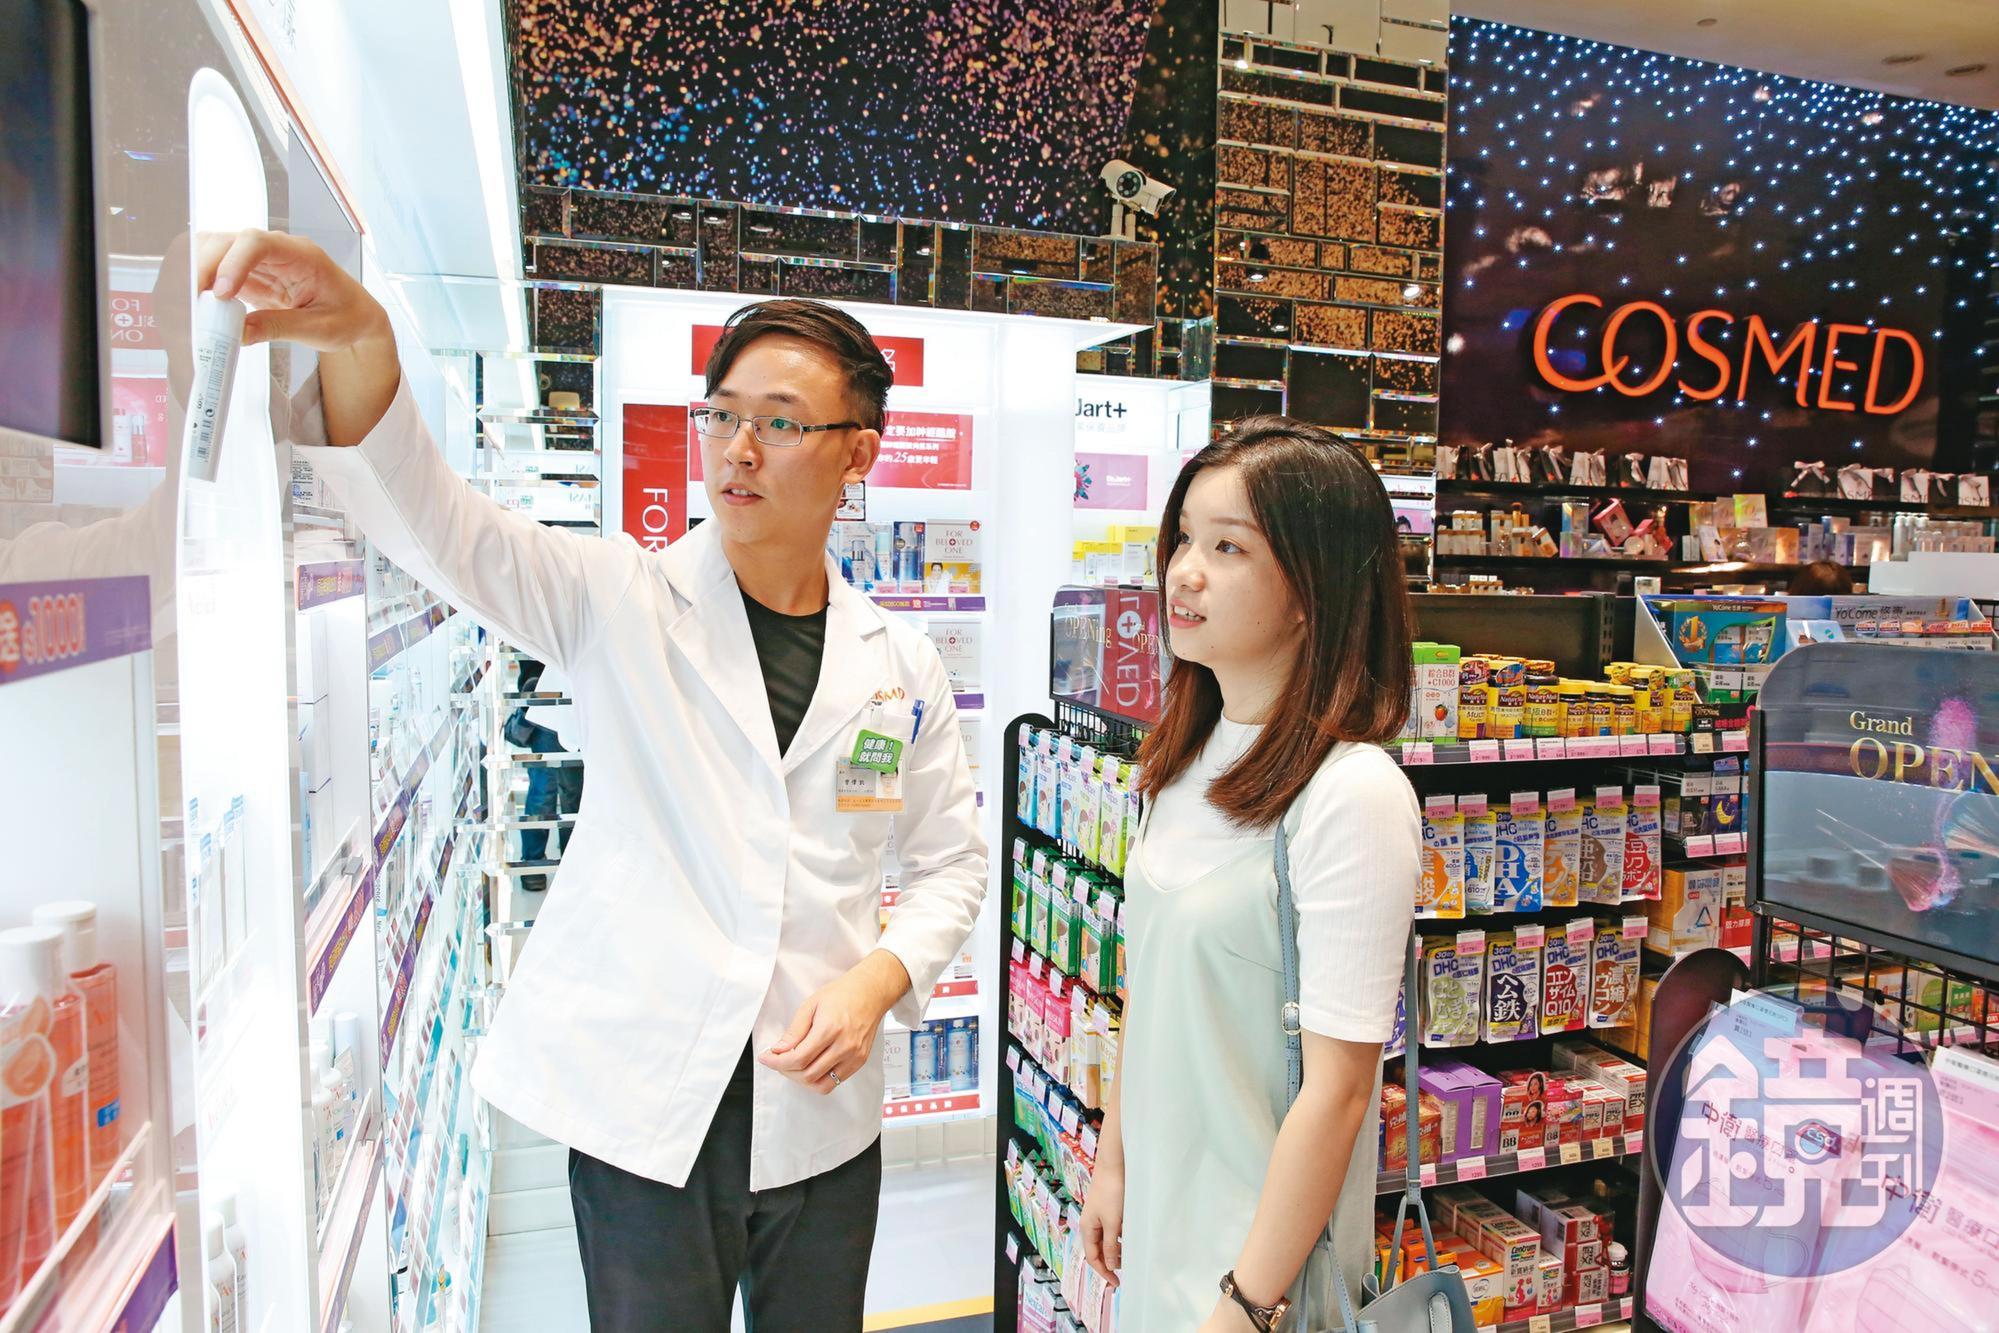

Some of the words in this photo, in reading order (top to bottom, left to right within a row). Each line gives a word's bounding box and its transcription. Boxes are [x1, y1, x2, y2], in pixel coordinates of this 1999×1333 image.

[1533, 293, 1925, 416] COSMED
[642, 487, 669, 553] FOR
[945, 529, 963, 538] FOR
[944, 547, 964, 555] ONE
[1849, 710, 1913, 736] Grand
[858, 751, 895, 764] 就問我
[1849, 737, 1999, 797] OPEN
[1547, 947, 1570, 964] DHC
[1596, 943, 1620, 959] DHC
[1433, 959, 1459, 976] DHC
[1492, 955, 1518, 972] DHC
[1546, 971, 1573, 985] コエン
[1494, 974, 1521, 1022] ヘム鉄
[1549, 985, 1576, 999] ザイム
[1593, 973, 1611, 1012] ウコン
[1546, 999, 1571, 1016] Q10
[1701, 1101, 1743, 1142] 中衛
[1502, 1137, 1516, 1148] BB
[1546, 1131, 1558, 1140] BB
[1510, 1244, 1537, 1255] Centrum
